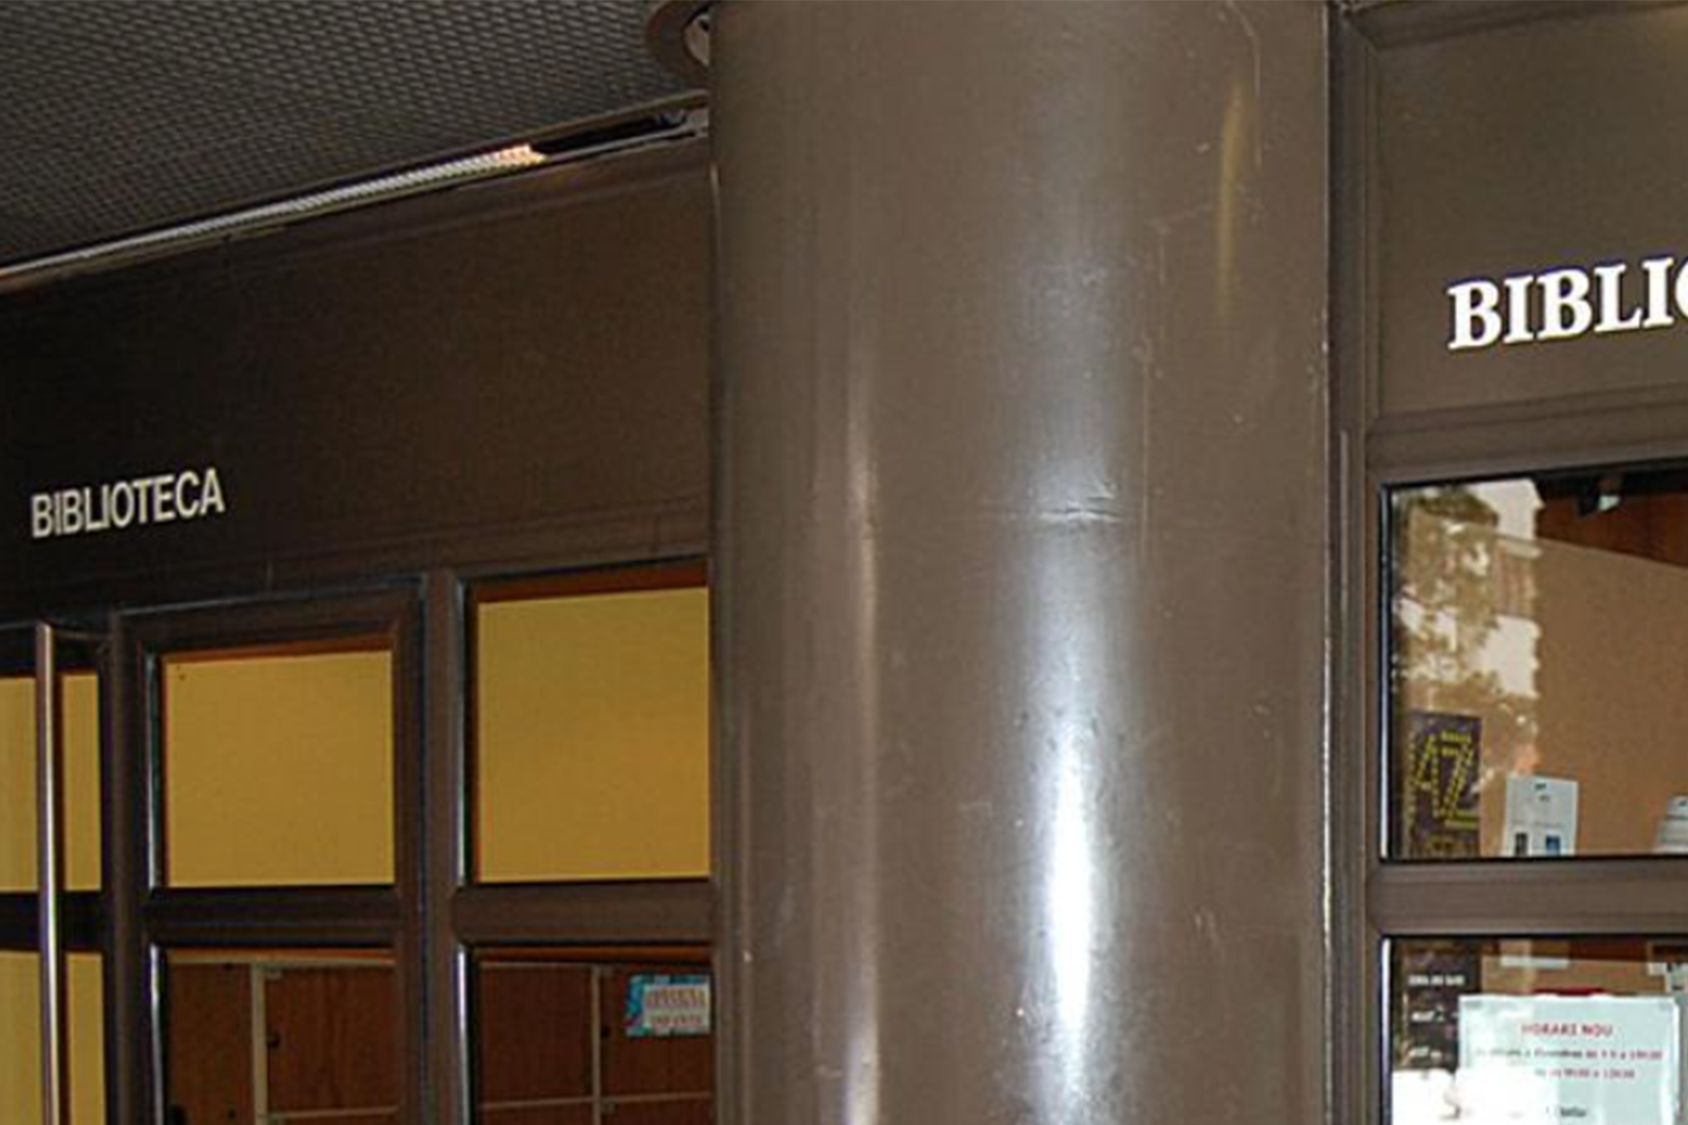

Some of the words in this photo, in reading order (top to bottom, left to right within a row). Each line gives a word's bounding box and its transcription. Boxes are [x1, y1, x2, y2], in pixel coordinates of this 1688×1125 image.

[31, 467, 226, 538] BIBLIOTECA
[1521, 1023, 1577, 1037] HORARI
[1582, 1023, 1613, 1038] NOU
